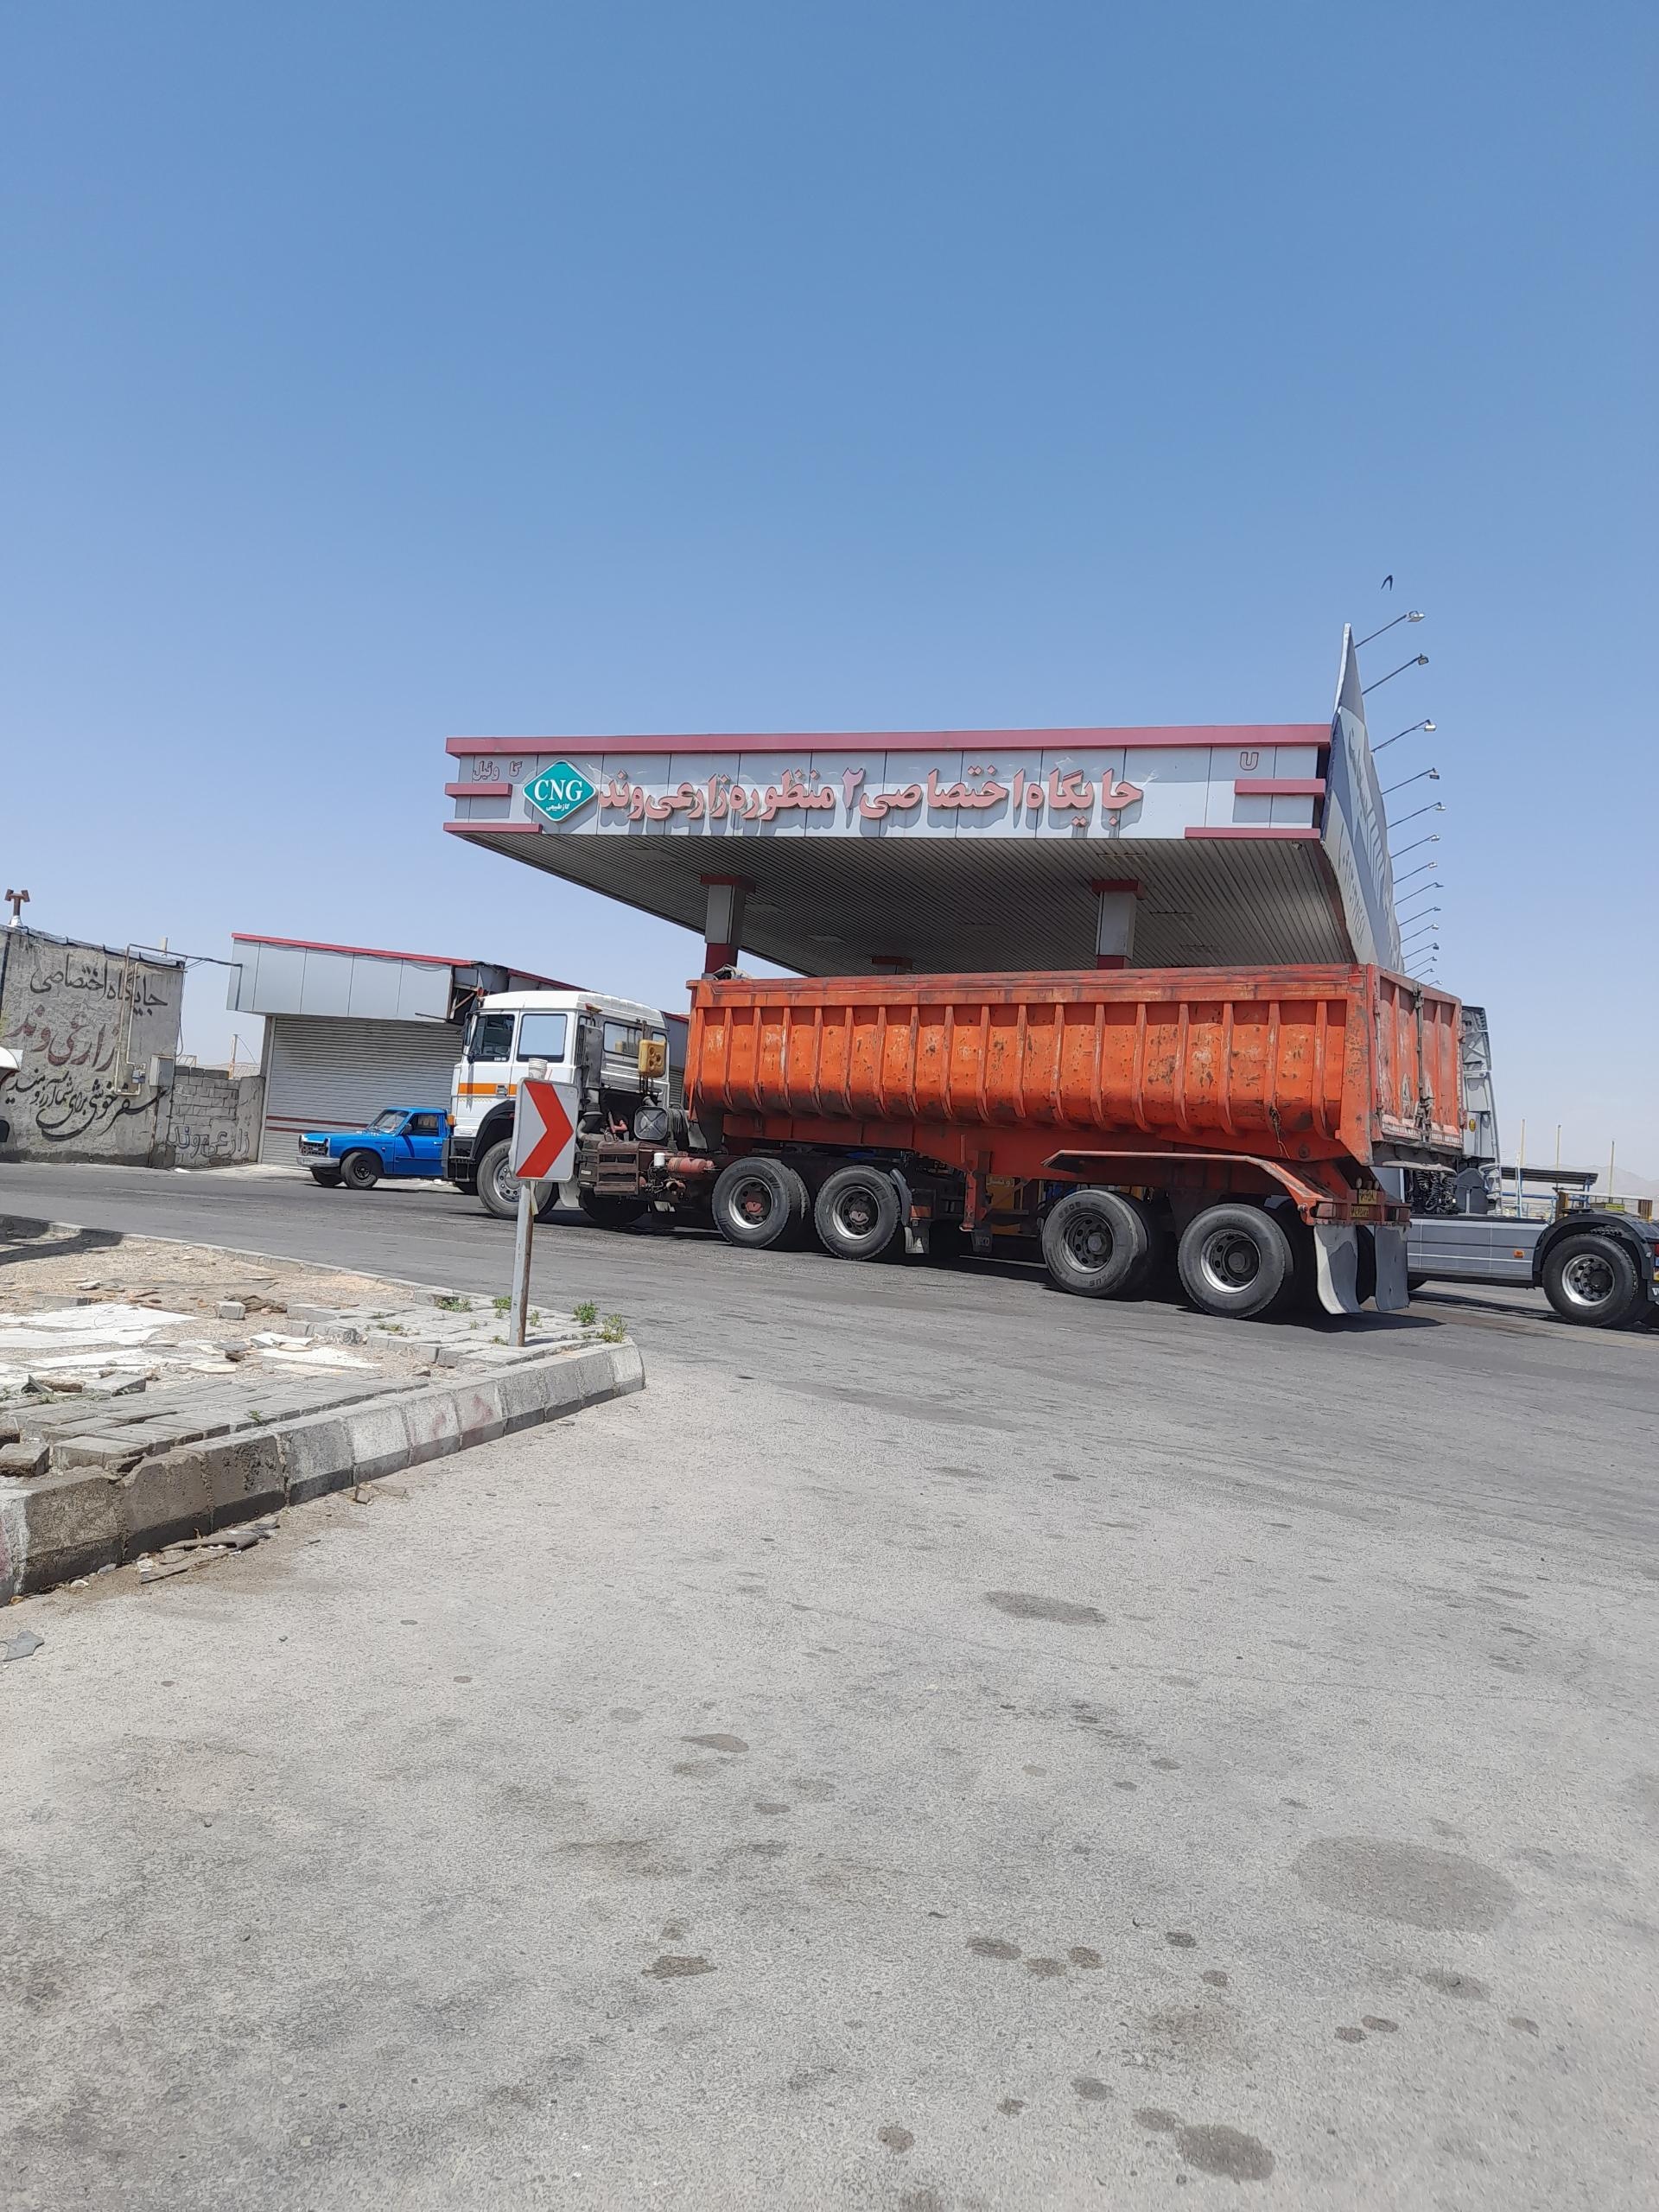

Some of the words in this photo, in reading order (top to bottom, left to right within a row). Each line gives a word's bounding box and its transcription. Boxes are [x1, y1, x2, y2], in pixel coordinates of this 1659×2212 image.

[534, 779, 583, 802] CNG
[730, 768, 836, 821] منظوره
[859, 765, 1026, 820] اختصاصی
[1027, 767, 1143, 827] جایگاه
[29, 952, 108, 1002] اختصاصی
